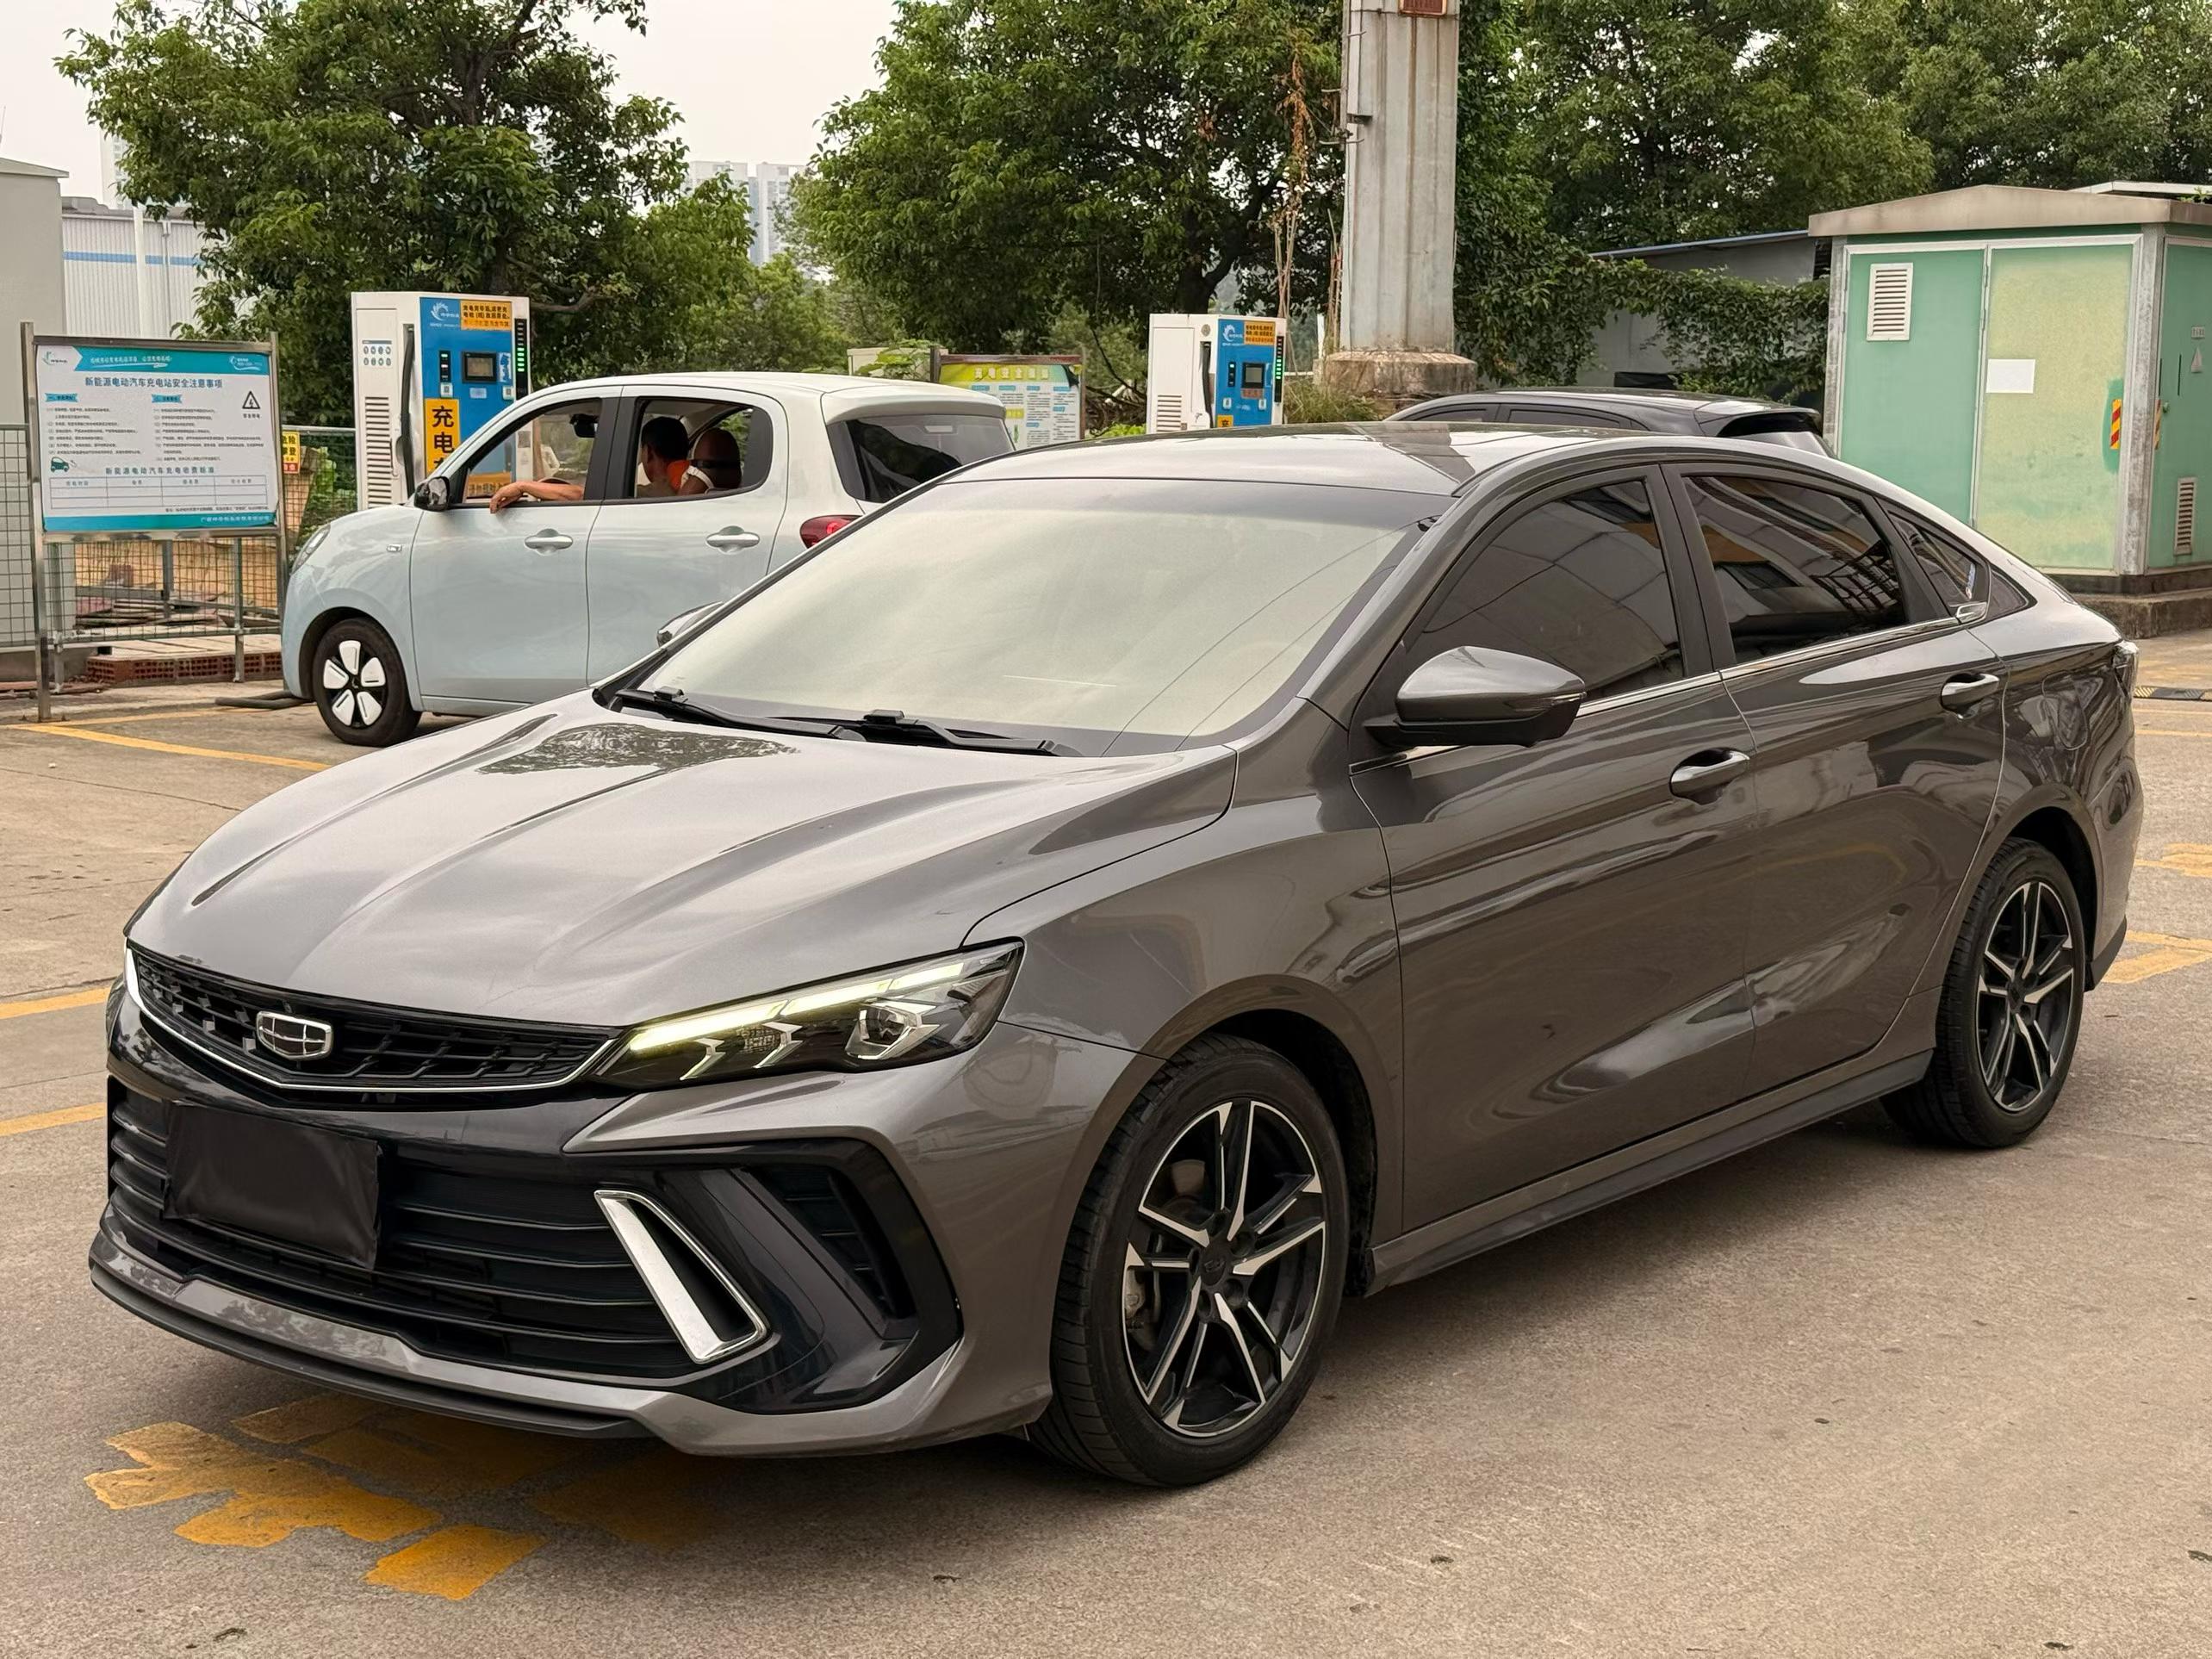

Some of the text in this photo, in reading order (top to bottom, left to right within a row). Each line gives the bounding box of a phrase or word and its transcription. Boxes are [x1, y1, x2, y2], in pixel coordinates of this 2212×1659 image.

[84, 376, 223, 388] 新能源电动汽车充电站安全注意事项
[105, 466, 214, 475] 新能源电动汽车充电收费标准
